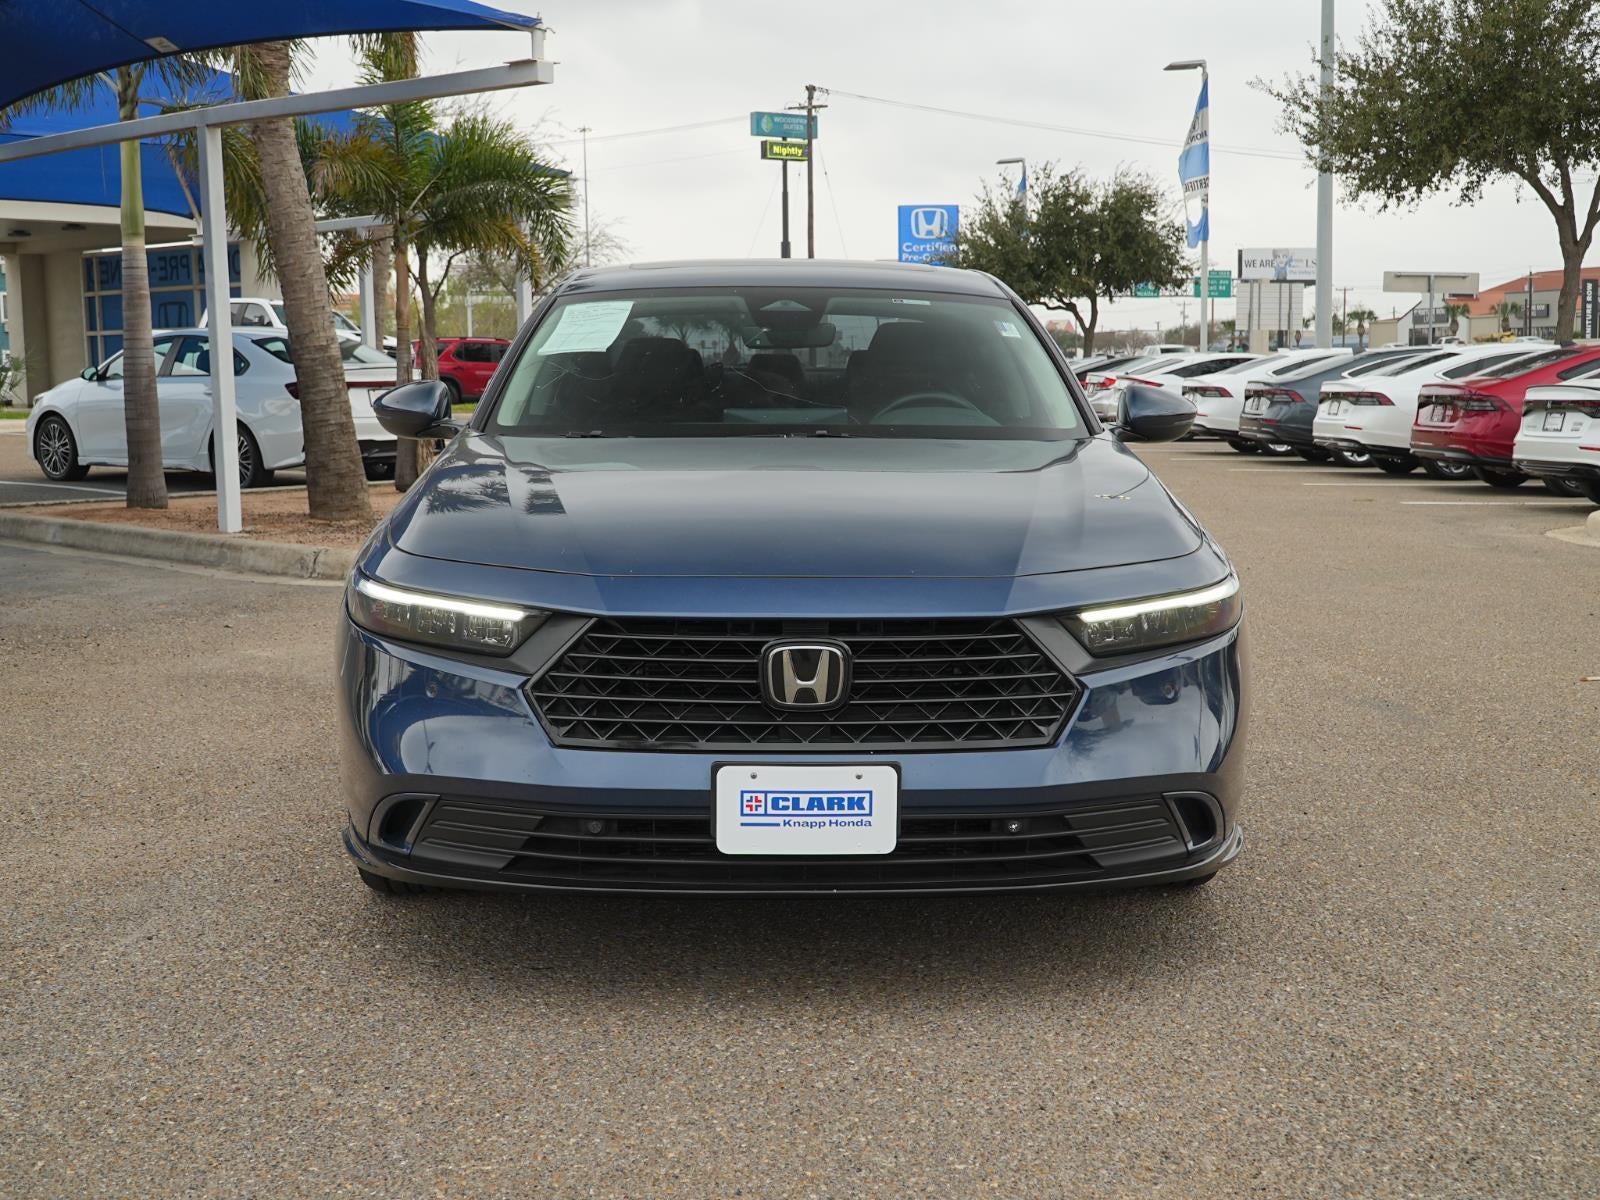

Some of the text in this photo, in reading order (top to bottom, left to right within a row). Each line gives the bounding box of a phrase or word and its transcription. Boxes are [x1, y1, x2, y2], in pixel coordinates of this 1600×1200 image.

[772, 145, 803, 156] Nightly
[1244, 259, 1257, 268] WE
[771, 796, 866, 812] CLARK
[783, 819, 872, 829] Knapp Honda
